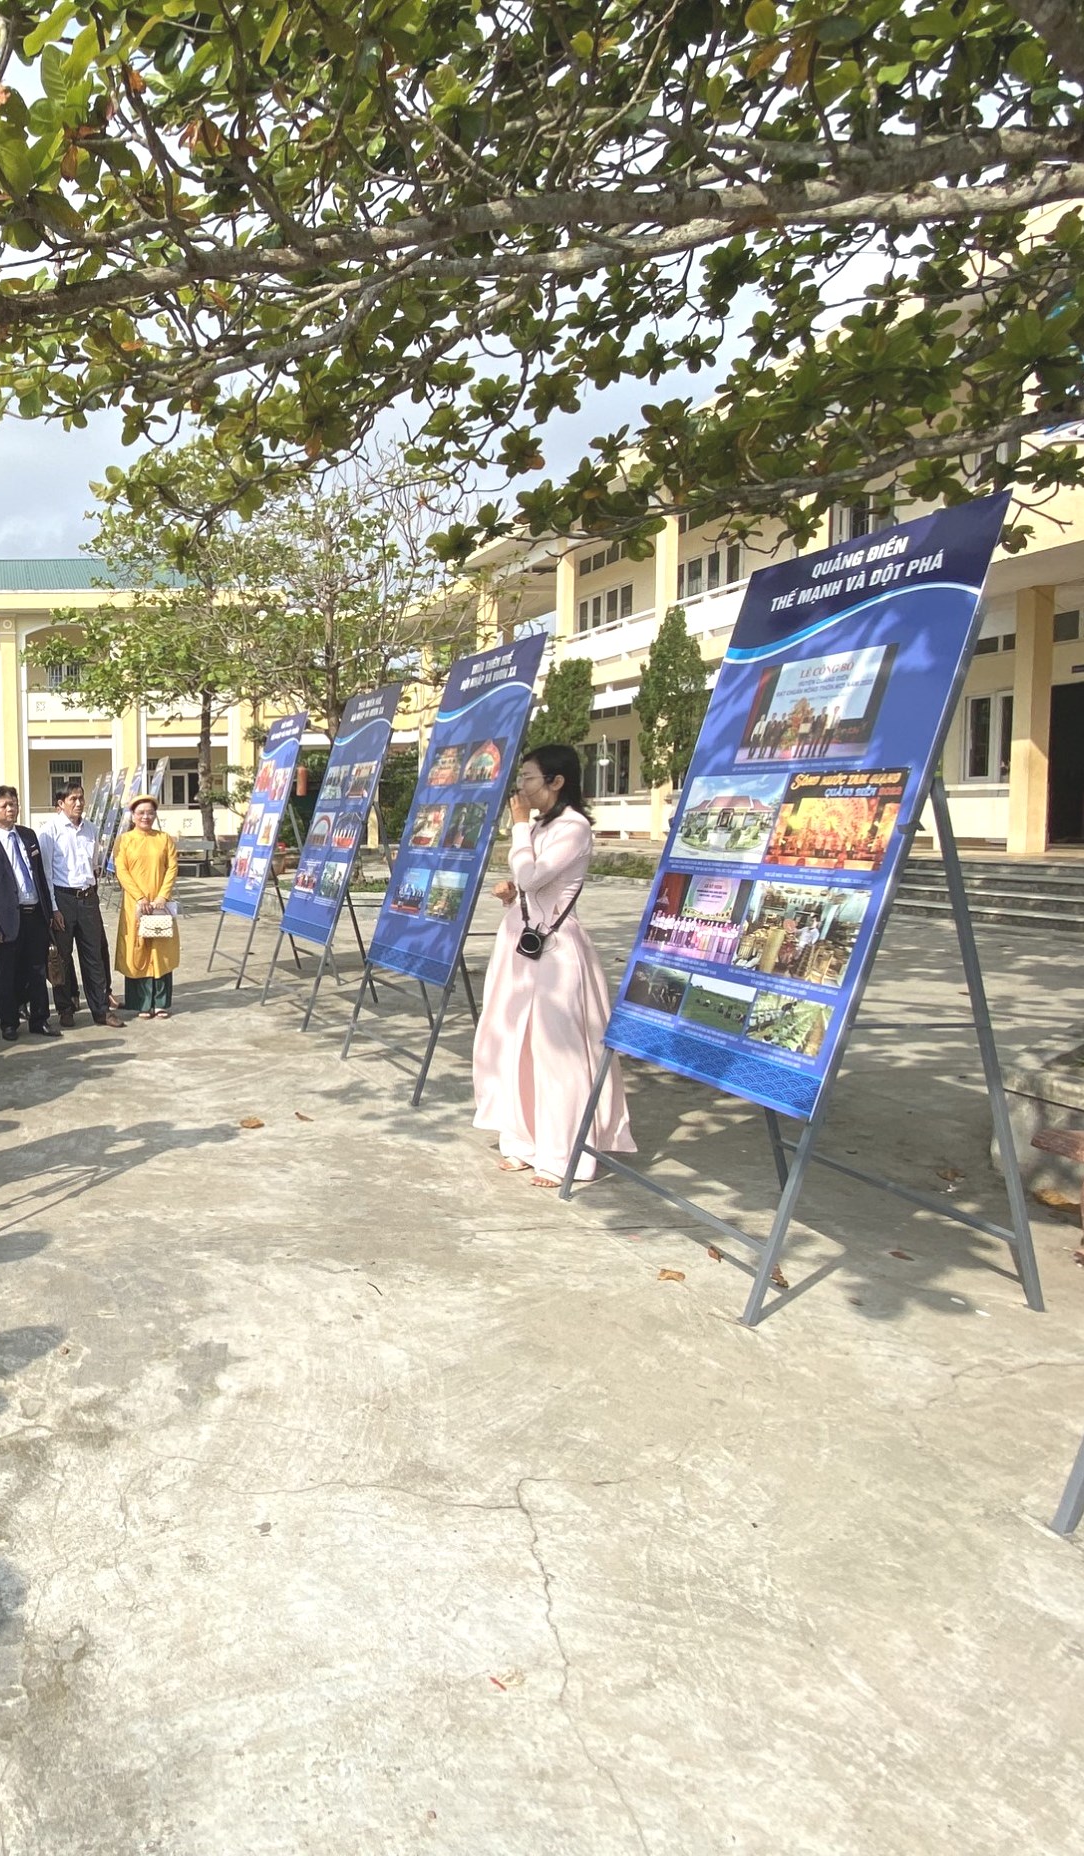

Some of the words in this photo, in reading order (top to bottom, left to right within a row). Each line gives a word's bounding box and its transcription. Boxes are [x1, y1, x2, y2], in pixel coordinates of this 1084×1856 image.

[770, 587, 799, 612] THẾ
[797, 578, 844, 605] MẠNH
[845, 570, 866, 593] VÀ
[869, 561, 904, 587] ĐỘT
[905, 548, 944, 577] PHÁ
[811, 551, 865, 579] QUẢNG
[866, 534, 910, 563] ĐIỀN
